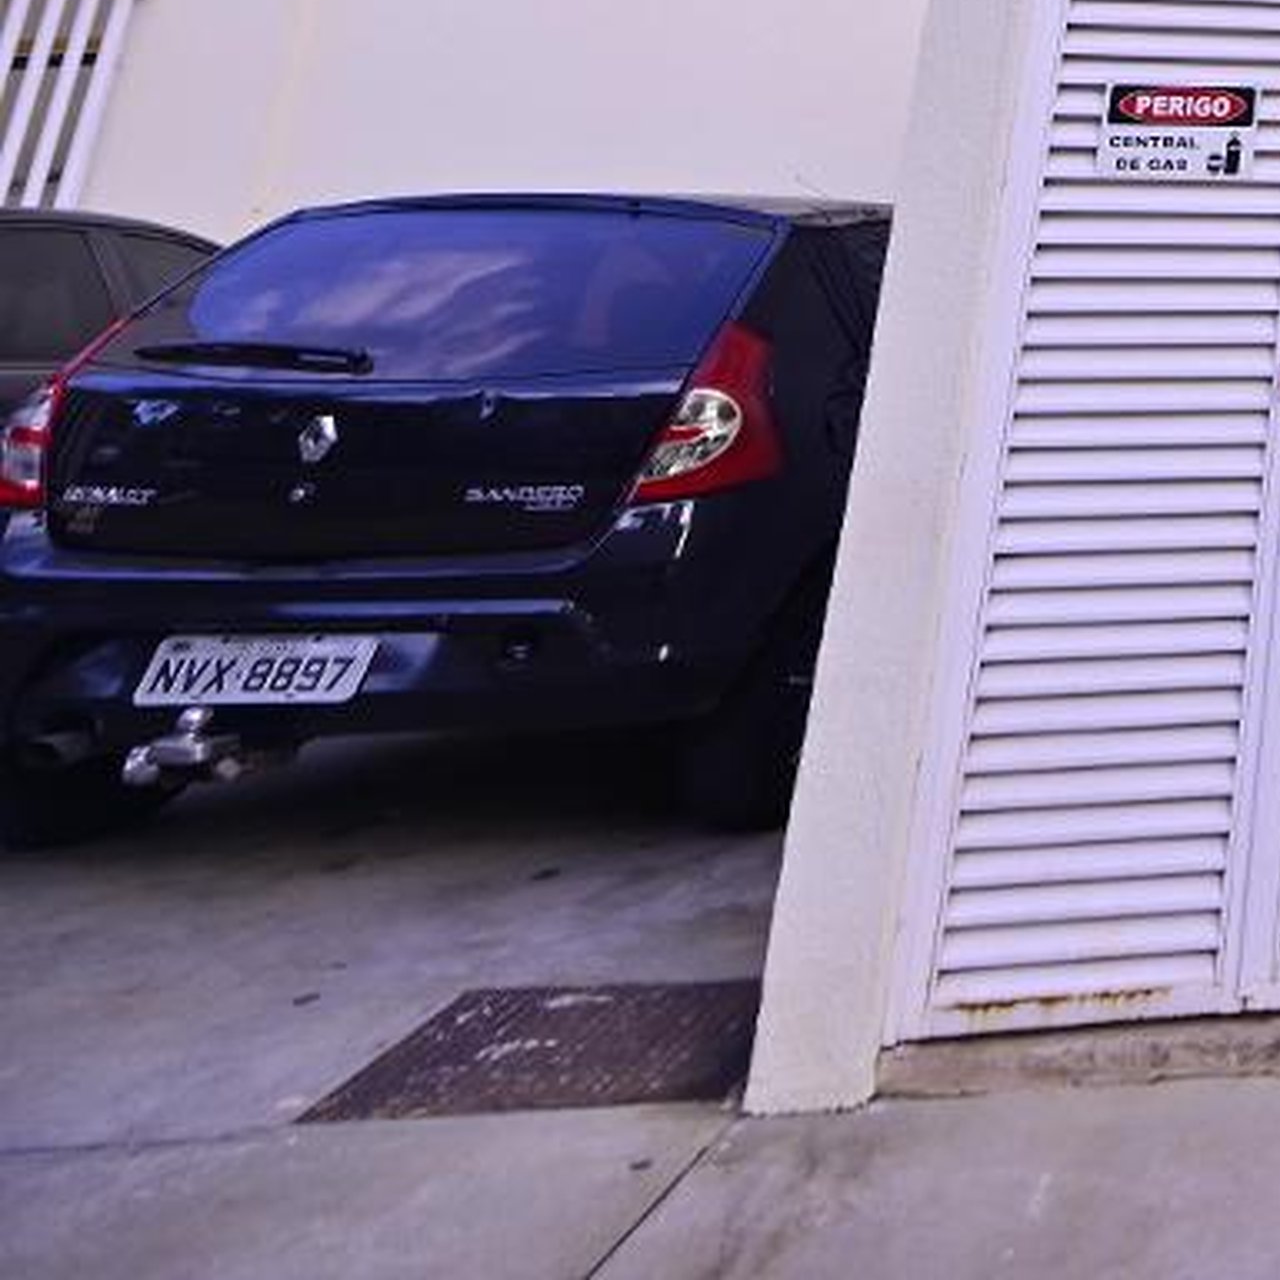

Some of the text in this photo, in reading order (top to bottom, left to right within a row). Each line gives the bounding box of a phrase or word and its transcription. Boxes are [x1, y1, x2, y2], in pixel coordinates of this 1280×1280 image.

[1134, 95, 1232, 118] PERIGO
[1109, 135, 1199, 150] CENTRAL
[1116, 157, 1141, 171] DE
